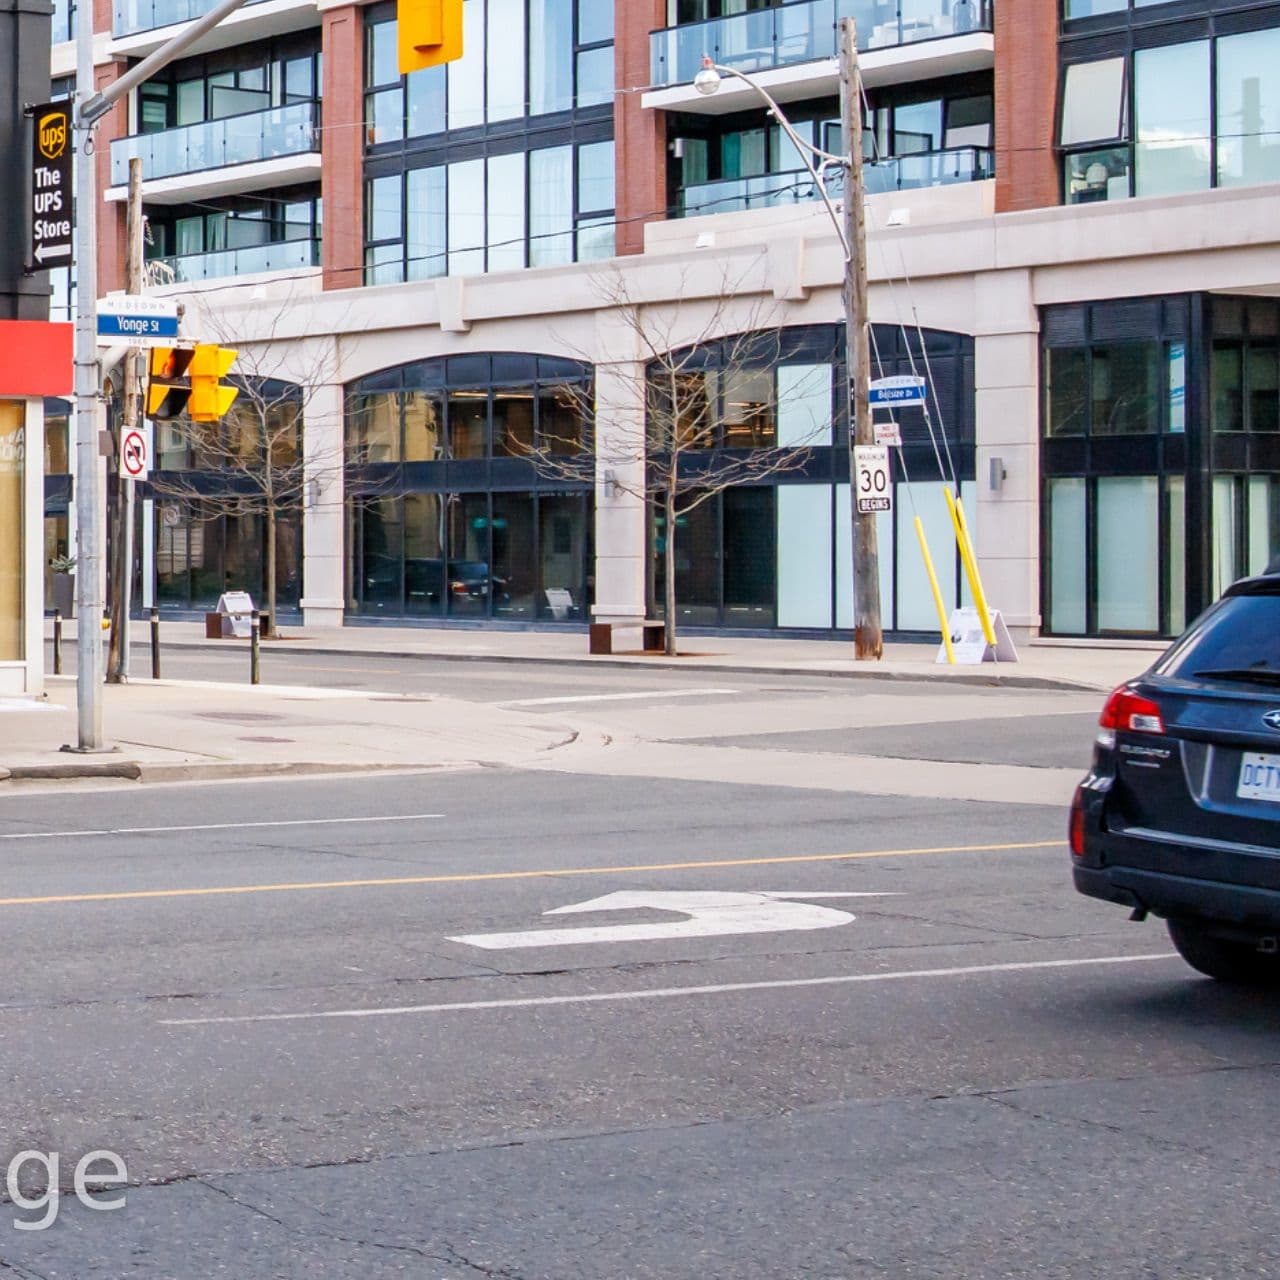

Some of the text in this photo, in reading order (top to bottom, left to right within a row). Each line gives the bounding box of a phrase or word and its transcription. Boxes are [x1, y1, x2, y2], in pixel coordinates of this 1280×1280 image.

[41, 126, 64, 152] ups
[35, 168, 60, 187] The
[34, 191, 62, 213] UPS
[34, 220, 70, 239] Store
[117, 316, 160, 334] Yonge St
[861, 469, 886, 492] 30
[861, 500, 888, 510] BEGINS
